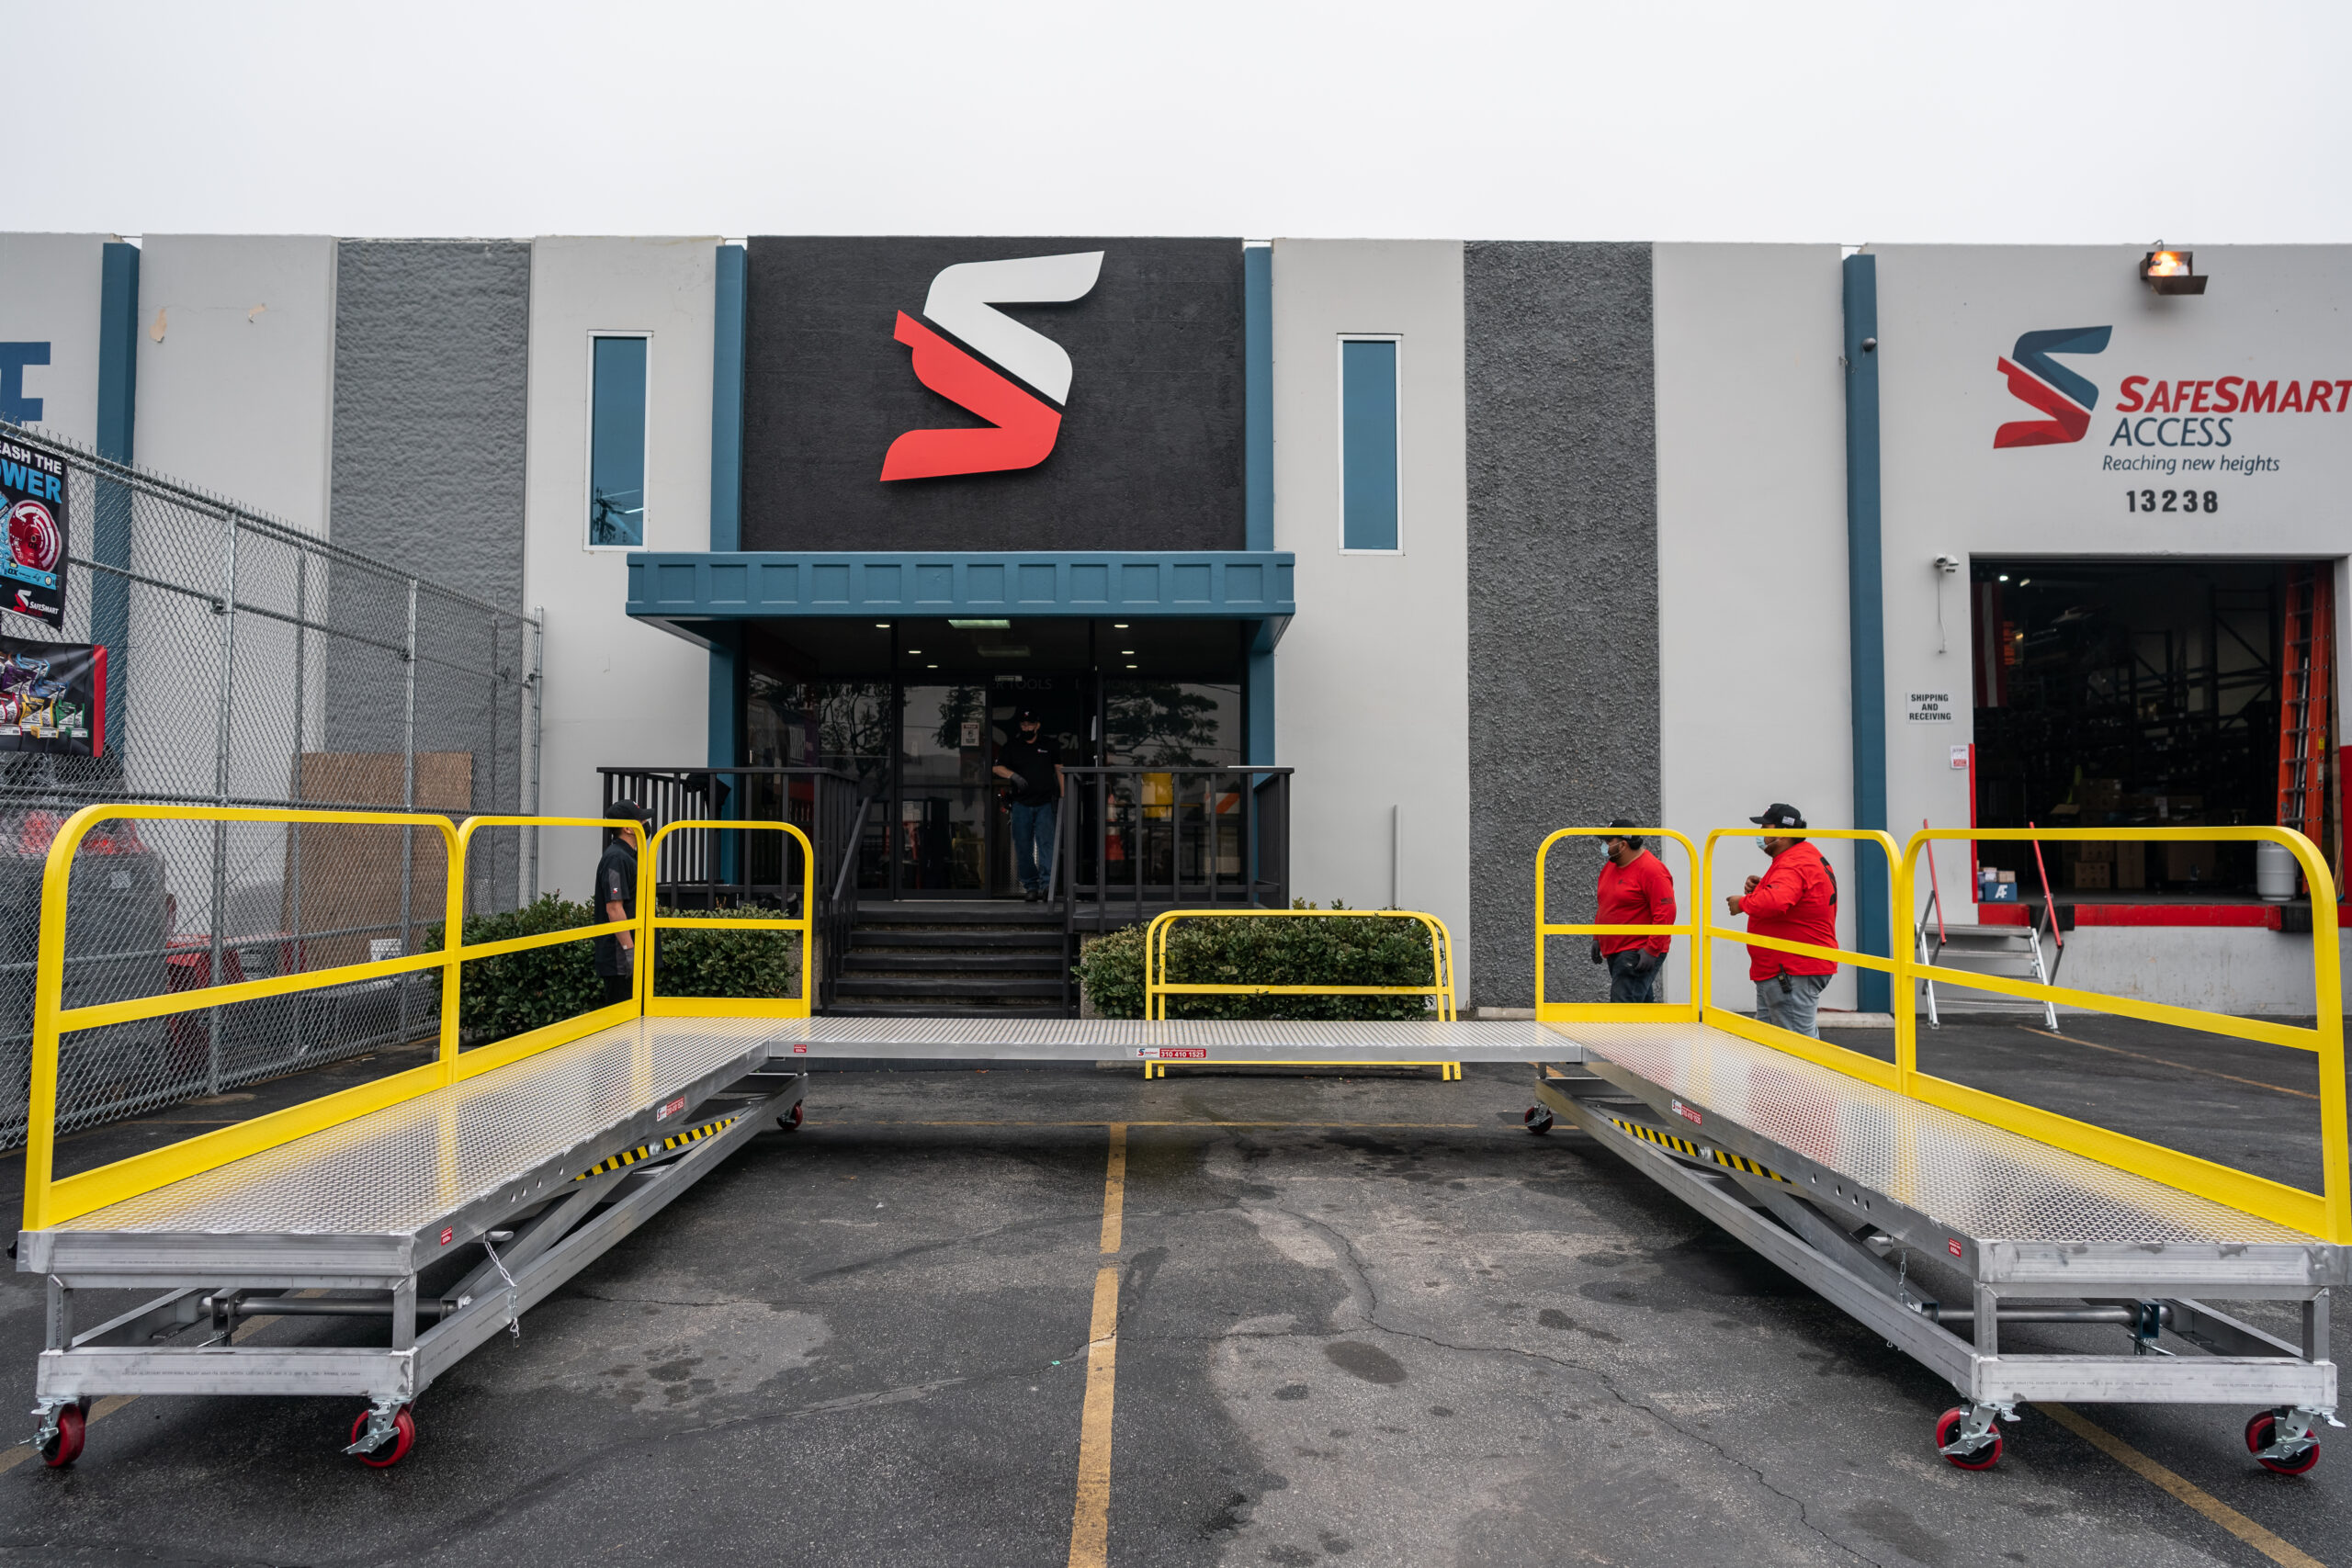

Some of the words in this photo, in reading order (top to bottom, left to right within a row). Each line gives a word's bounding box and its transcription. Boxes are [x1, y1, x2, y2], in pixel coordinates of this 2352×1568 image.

[2115, 375, 2352, 413] SAFESMART
[2109, 417, 2233, 447] ACCESS
[0, 441, 31, 464] ASH
[34, 454, 62, 476] THE
[2102, 455, 2177, 476] Reaching
[2181, 458, 2216, 472] new
[2220, 455, 2280, 476] heights
[0, 458, 62, 505] WER
[2125, 489, 2219, 513] 13238
[1911, 694, 1949, 702] SHIPPING
[1921, 703, 1939, 711] AND
[1909, 712, 1951, 721] RECEIVING
